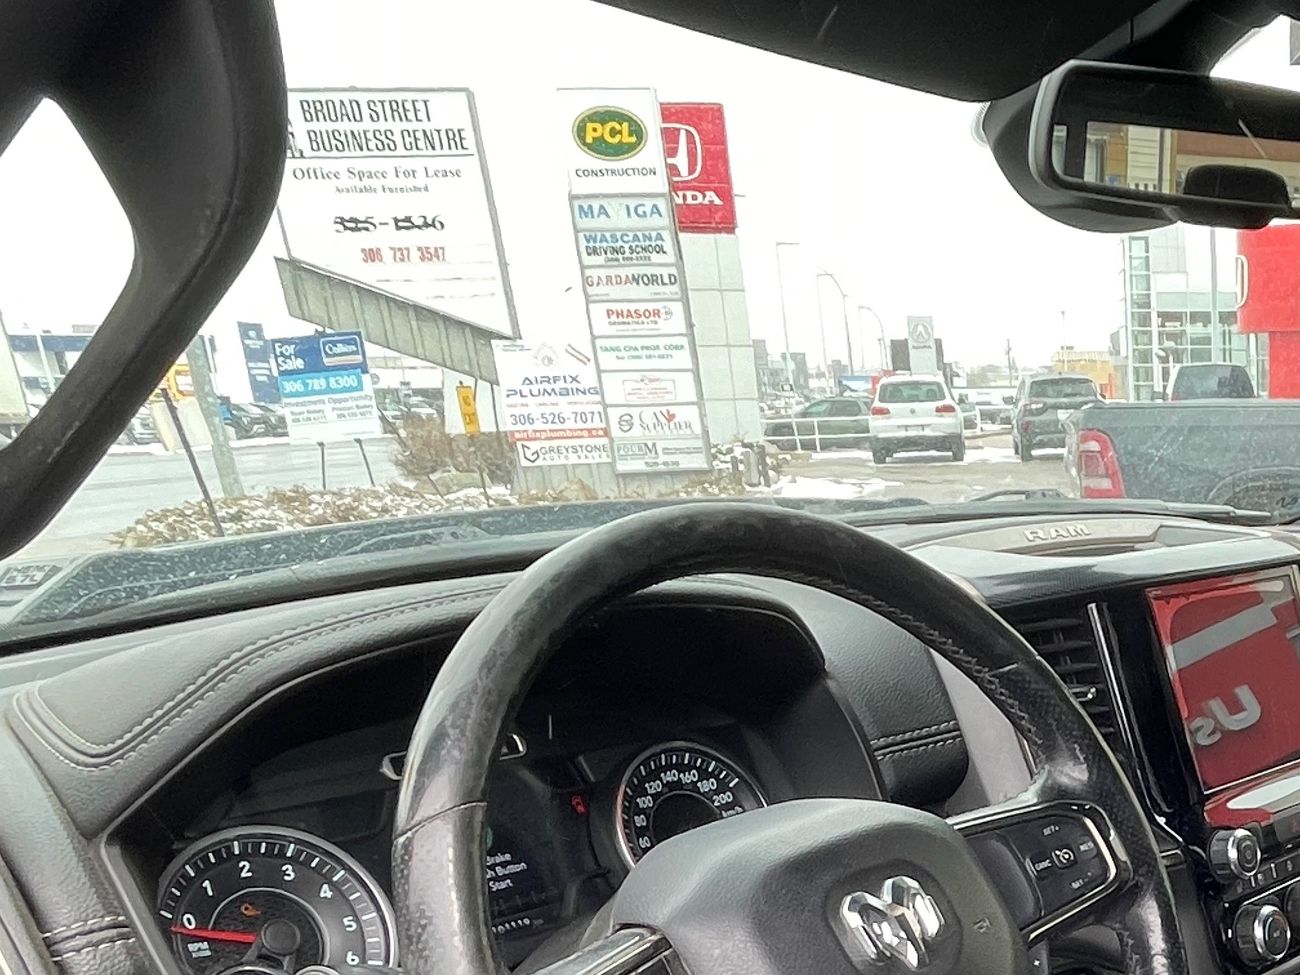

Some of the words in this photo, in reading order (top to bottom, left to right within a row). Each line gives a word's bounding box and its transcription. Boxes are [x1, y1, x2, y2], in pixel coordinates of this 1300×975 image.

[299, 99, 363, 123] BROAD
[367, 98, 432, 122] STREET
[585, 121, 637, 144] PCL
[307, 128, 397, 152] BUSINESS
[400, 128, 469, 151] CENTRE
[292, 166, 341, 180] Office
[347, 166, 388, 182] Space
[394, 166, 418, 179] For
[424, 166, 462, 178] Lease
[575, 167, 657, 178] CONSTRUCTION
[335, 185, 377, 194] Available
[382, 184, 429, 193] Furnished
[671, 190, 724, 205] NDA
[577, 203, 663, 219] MAIGA
[583, 232, 665, 244] WASCANA
[361, 247, 384, 263] 306
[388, 246, 411, 263] 737
[416, 246, 446, 262] 3547
[585, 245, 626, 256] DRIVING
[628, 244, 667, 255] SCHOOL
[606, 308, 661, 319] PHASOR
[274, 342, 296, 356] For
[277, 355, 305, 370] Sale
[281, 380, 304, 393] 306
[305, 377, 326, 390] 789
[329, 375, 358, 389] 8300
[521, 374, 581, 385] AIRFIX
[506, 386, 600, 398] PLUMBING
[510, 410, 603, 426] 306-526-7071
[514, 428, 604, 439] airfixplumbing.ca
[540, 443, 609, 455] GREYSTONE
[1025, 523, 1091, 542] RAM
[661, 770, 679, 783] 140
[679, 769, 698, 783] 160
[645, 781, 662, 794] 120
[697, 779, 717, 792] 180
[636, 796, 653, 808] 100
[713, 791, 733, 805] 200
[634, 815, 646, 827] 80
[638, 836, 651, 849] 60
[239, 861, 252, 878] 2
[282, 865, 295, 881] 3
[495, 862, 527, 876] Button
[203, 880, 214, 896] 1
[319, 884, 333, 899] 4
[489, 879, 513, 891] Start
[183, 913, 196, 930] 0
[343, 916, 357, 931] 5
[346, 951, 360, 965] 6
